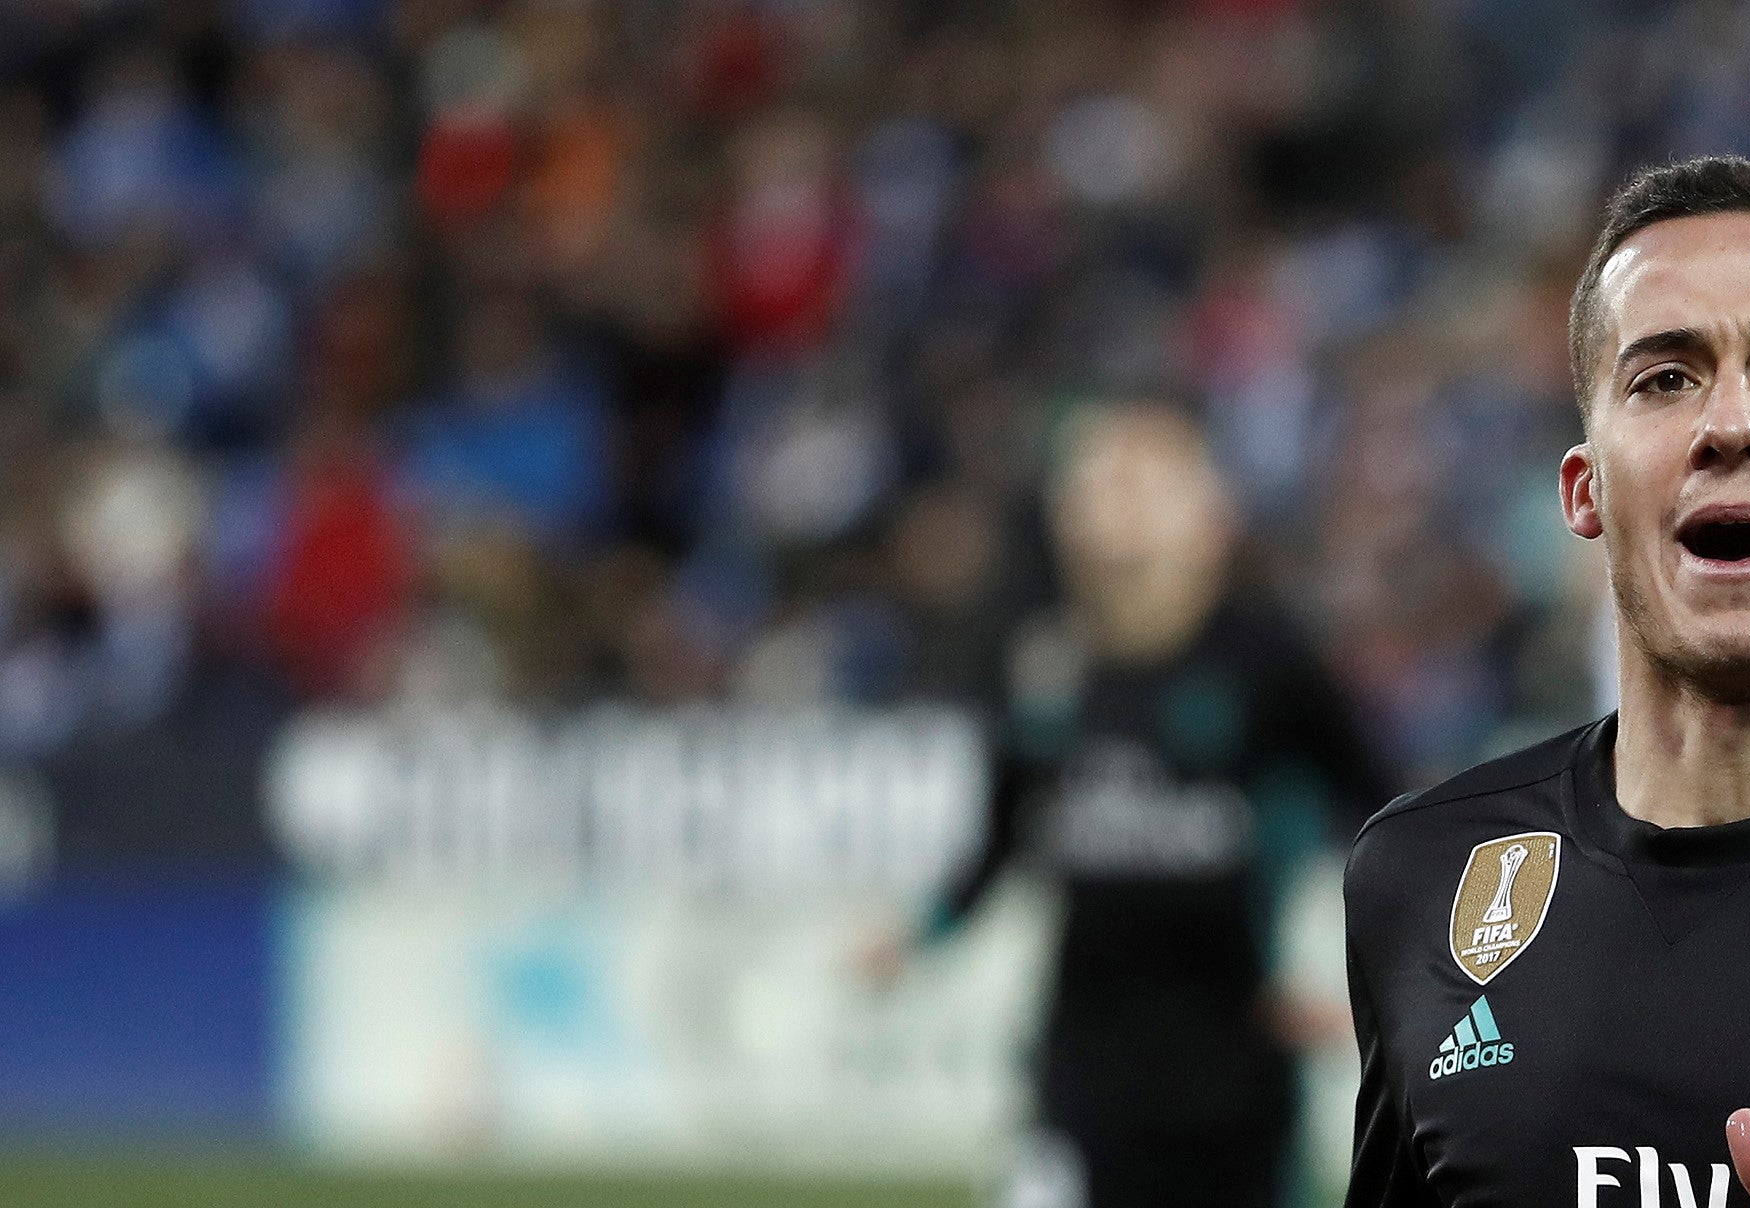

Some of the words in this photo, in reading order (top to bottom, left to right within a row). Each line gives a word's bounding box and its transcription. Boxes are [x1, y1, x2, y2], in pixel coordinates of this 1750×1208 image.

[1471, 923, 1513, 946] FIFA
[1475, 951, 1501, 966] 2017
[1428, 1041, 1515, 1080] adidas
